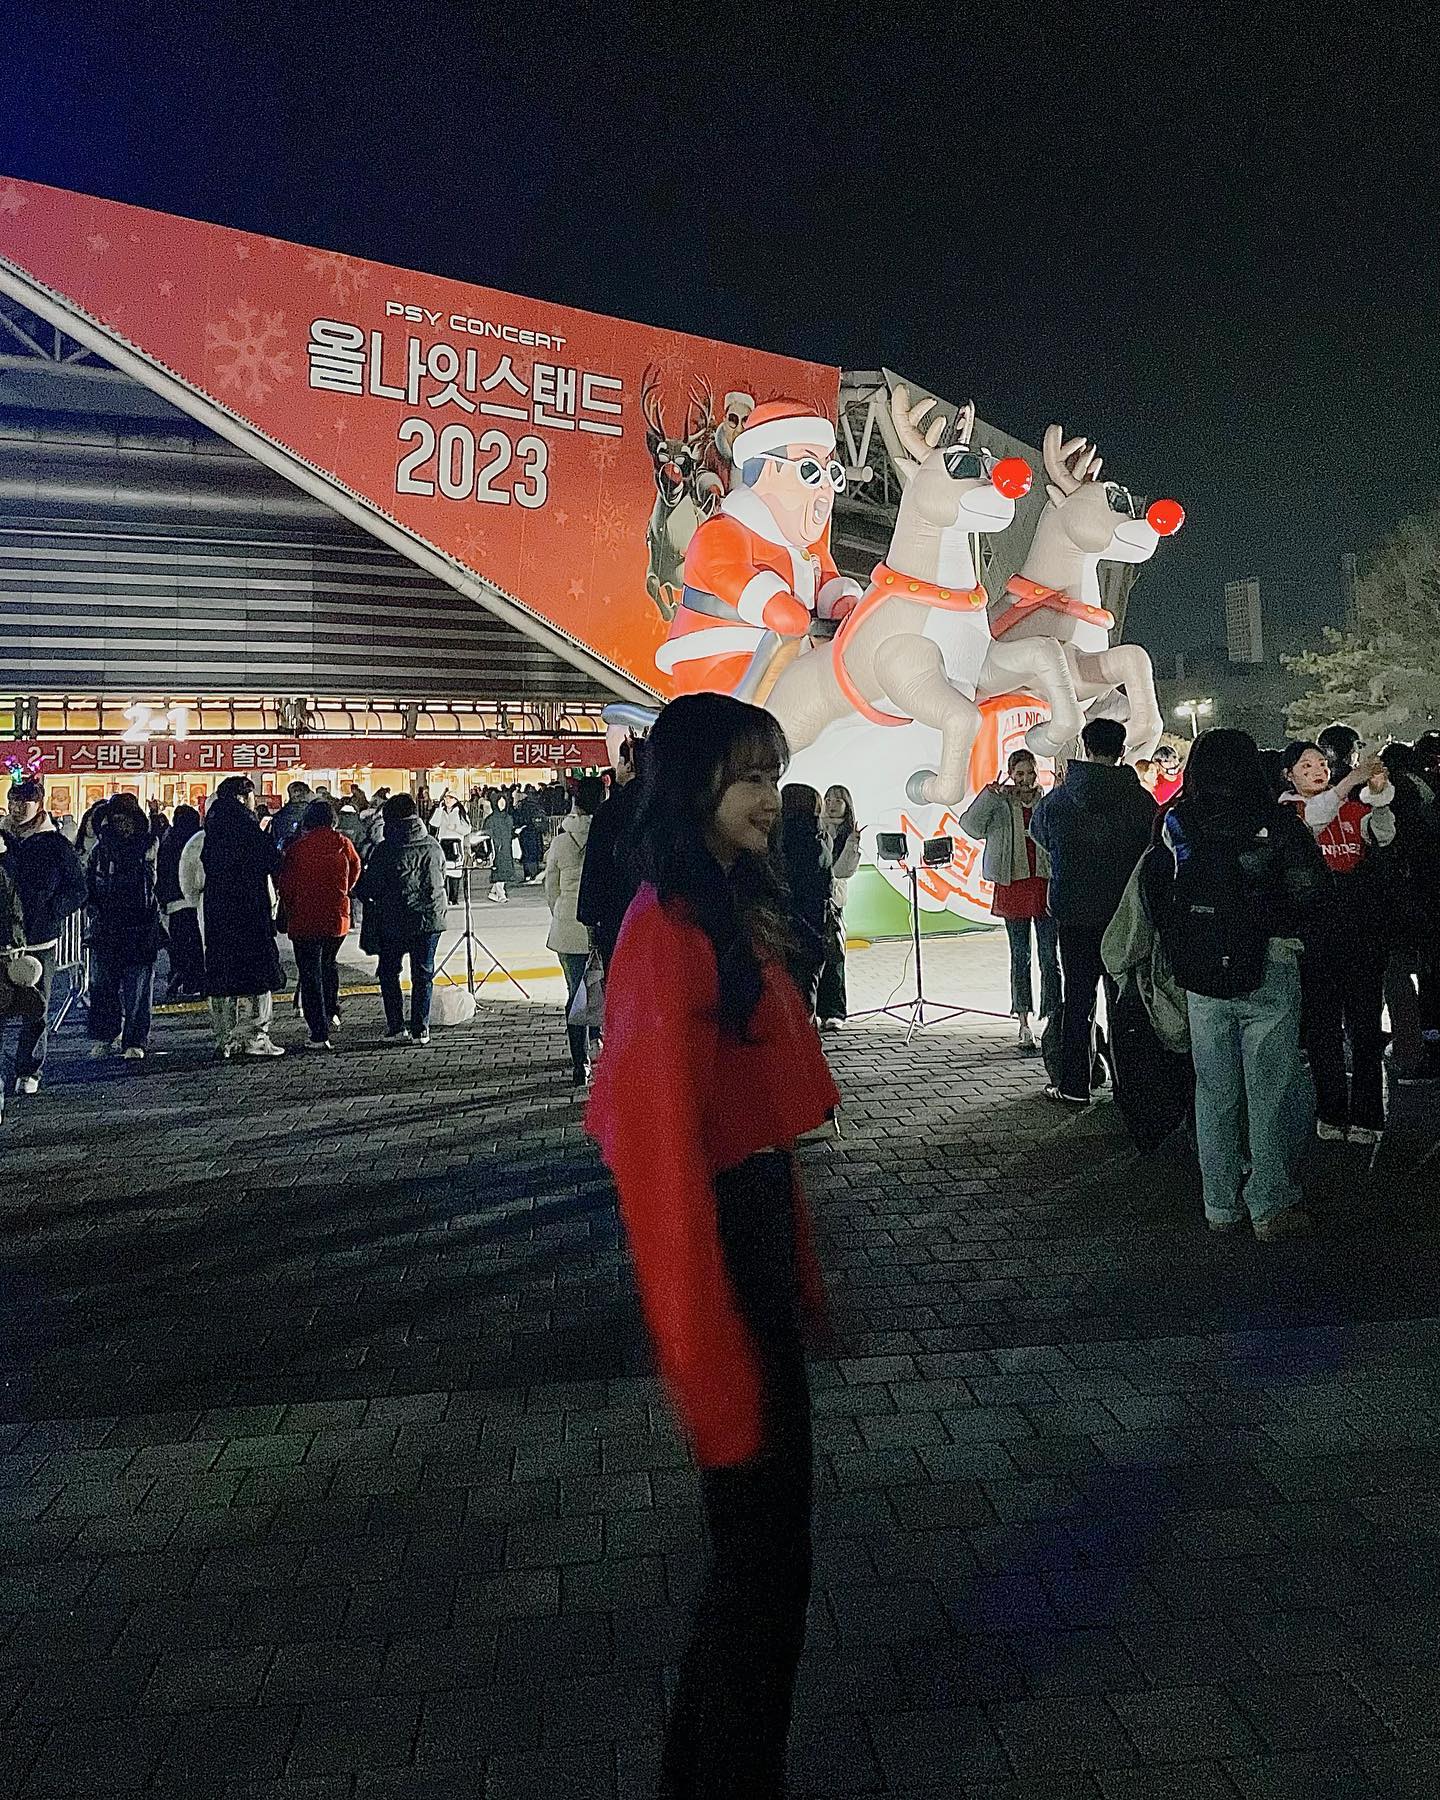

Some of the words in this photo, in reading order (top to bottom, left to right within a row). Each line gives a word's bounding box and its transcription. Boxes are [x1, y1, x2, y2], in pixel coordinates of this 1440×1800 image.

[386, 300, 443, 326] PSY
[449, 314, 567, 352] CONCERT
[307, 318, 624, 437] 올나잇스탠드
[396, 416, 549, 509] 2023
[70, 744, 146, 770] 스탠딩
[232, 743, 301, 768] 출입구
[513, 743, 582, 765] 티켓부스
